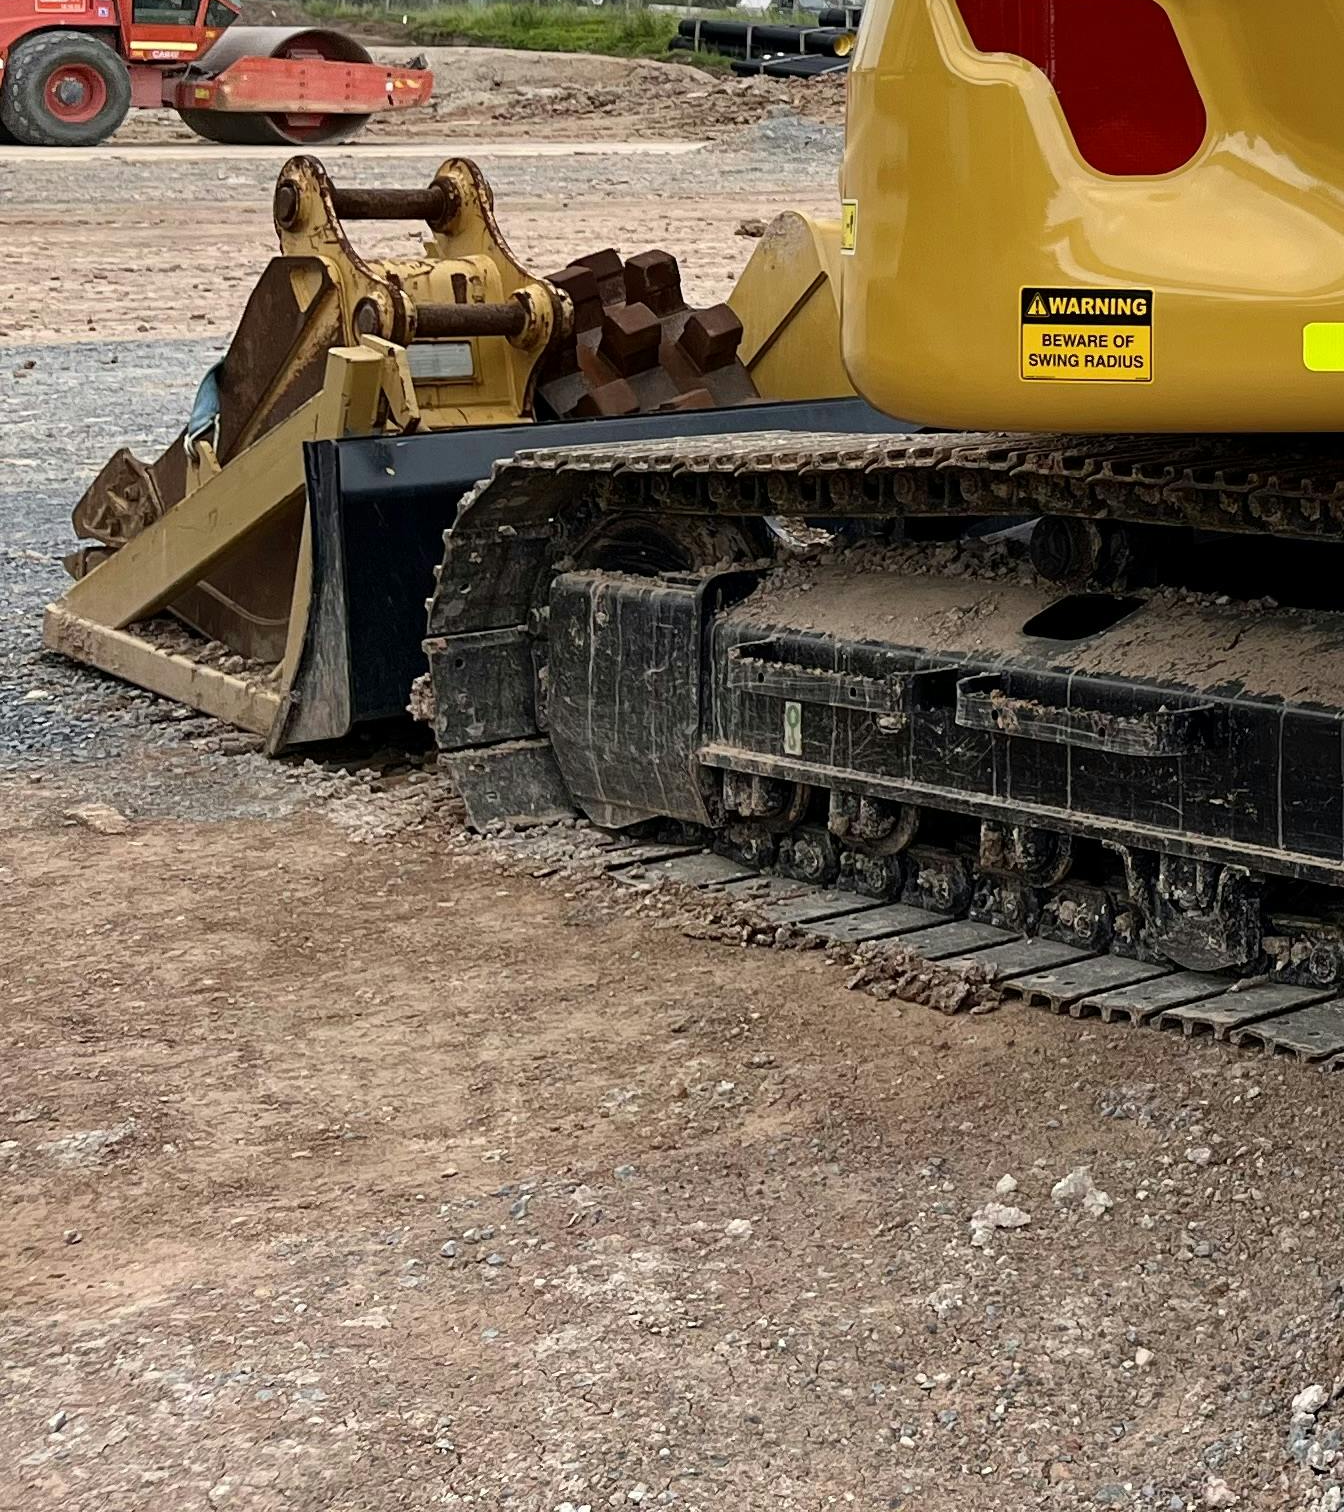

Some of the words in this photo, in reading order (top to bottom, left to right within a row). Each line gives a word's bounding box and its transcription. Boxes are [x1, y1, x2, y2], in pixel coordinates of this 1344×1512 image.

[1048, 297, 1147, 316] WARNING
[1042, 333, 1109, 348] BEWARE
[1113, 334, 1135, 348] OF
[1028, 353, 1080, 367] SWING
[1084, 354, 1144, 369] RADIUS
